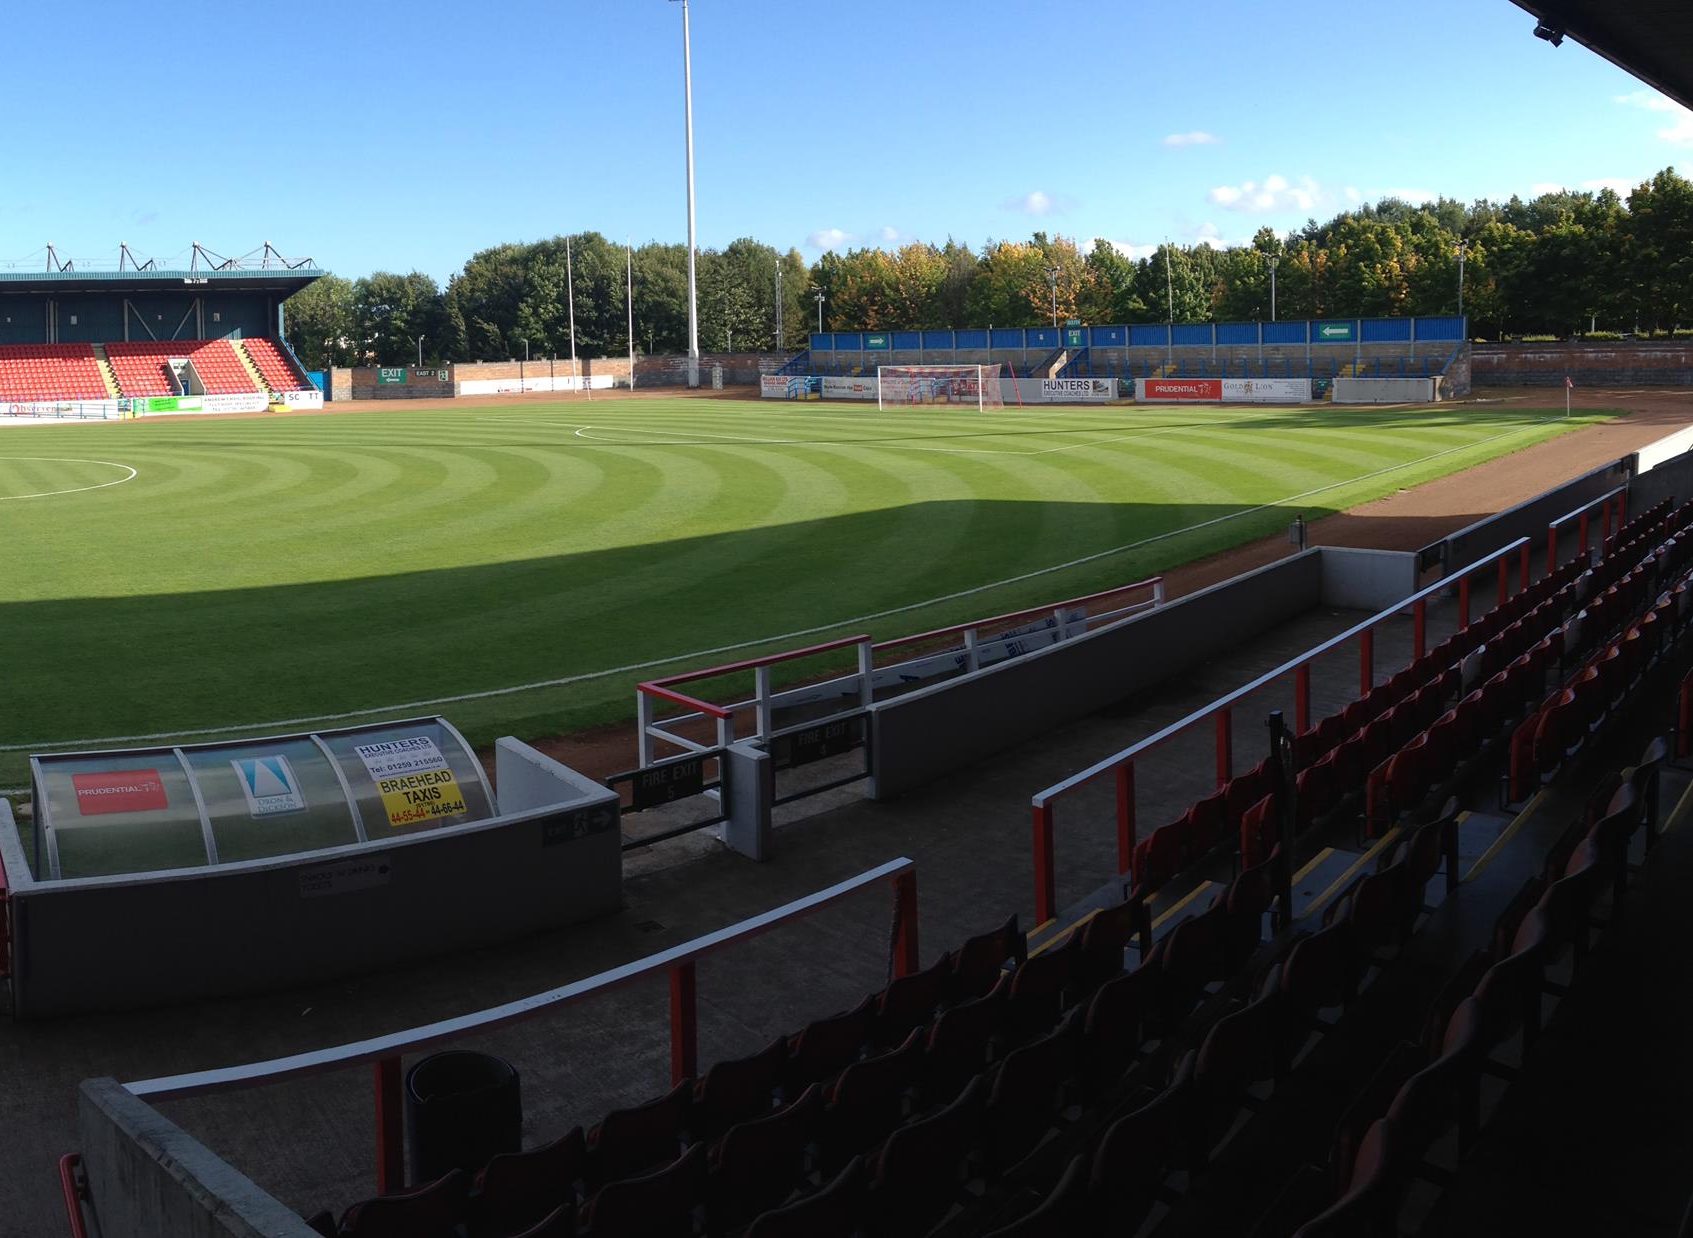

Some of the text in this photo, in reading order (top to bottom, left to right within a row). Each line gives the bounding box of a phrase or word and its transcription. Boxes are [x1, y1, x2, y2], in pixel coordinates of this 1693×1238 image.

[382, 368, 403, 377] EXIT
[1044, 381, 1090, 390] HUNTERS
[799, 722, 846, 745] FIRE EXIT
[359, 738, 429, 754] HUNTERS
[388, 761, 412, 771] 01259
[644, 760, 698, 788] FIRE EXIT
[380, 770, 452, 793] BRAEHEAD
[78, 784, 141, 796] PRUDENTIAL
[403, 787, 441, 804] TAXIS
[258, 797, 284, 806] DRON
[257, 802, 297, 814] DICKSON
